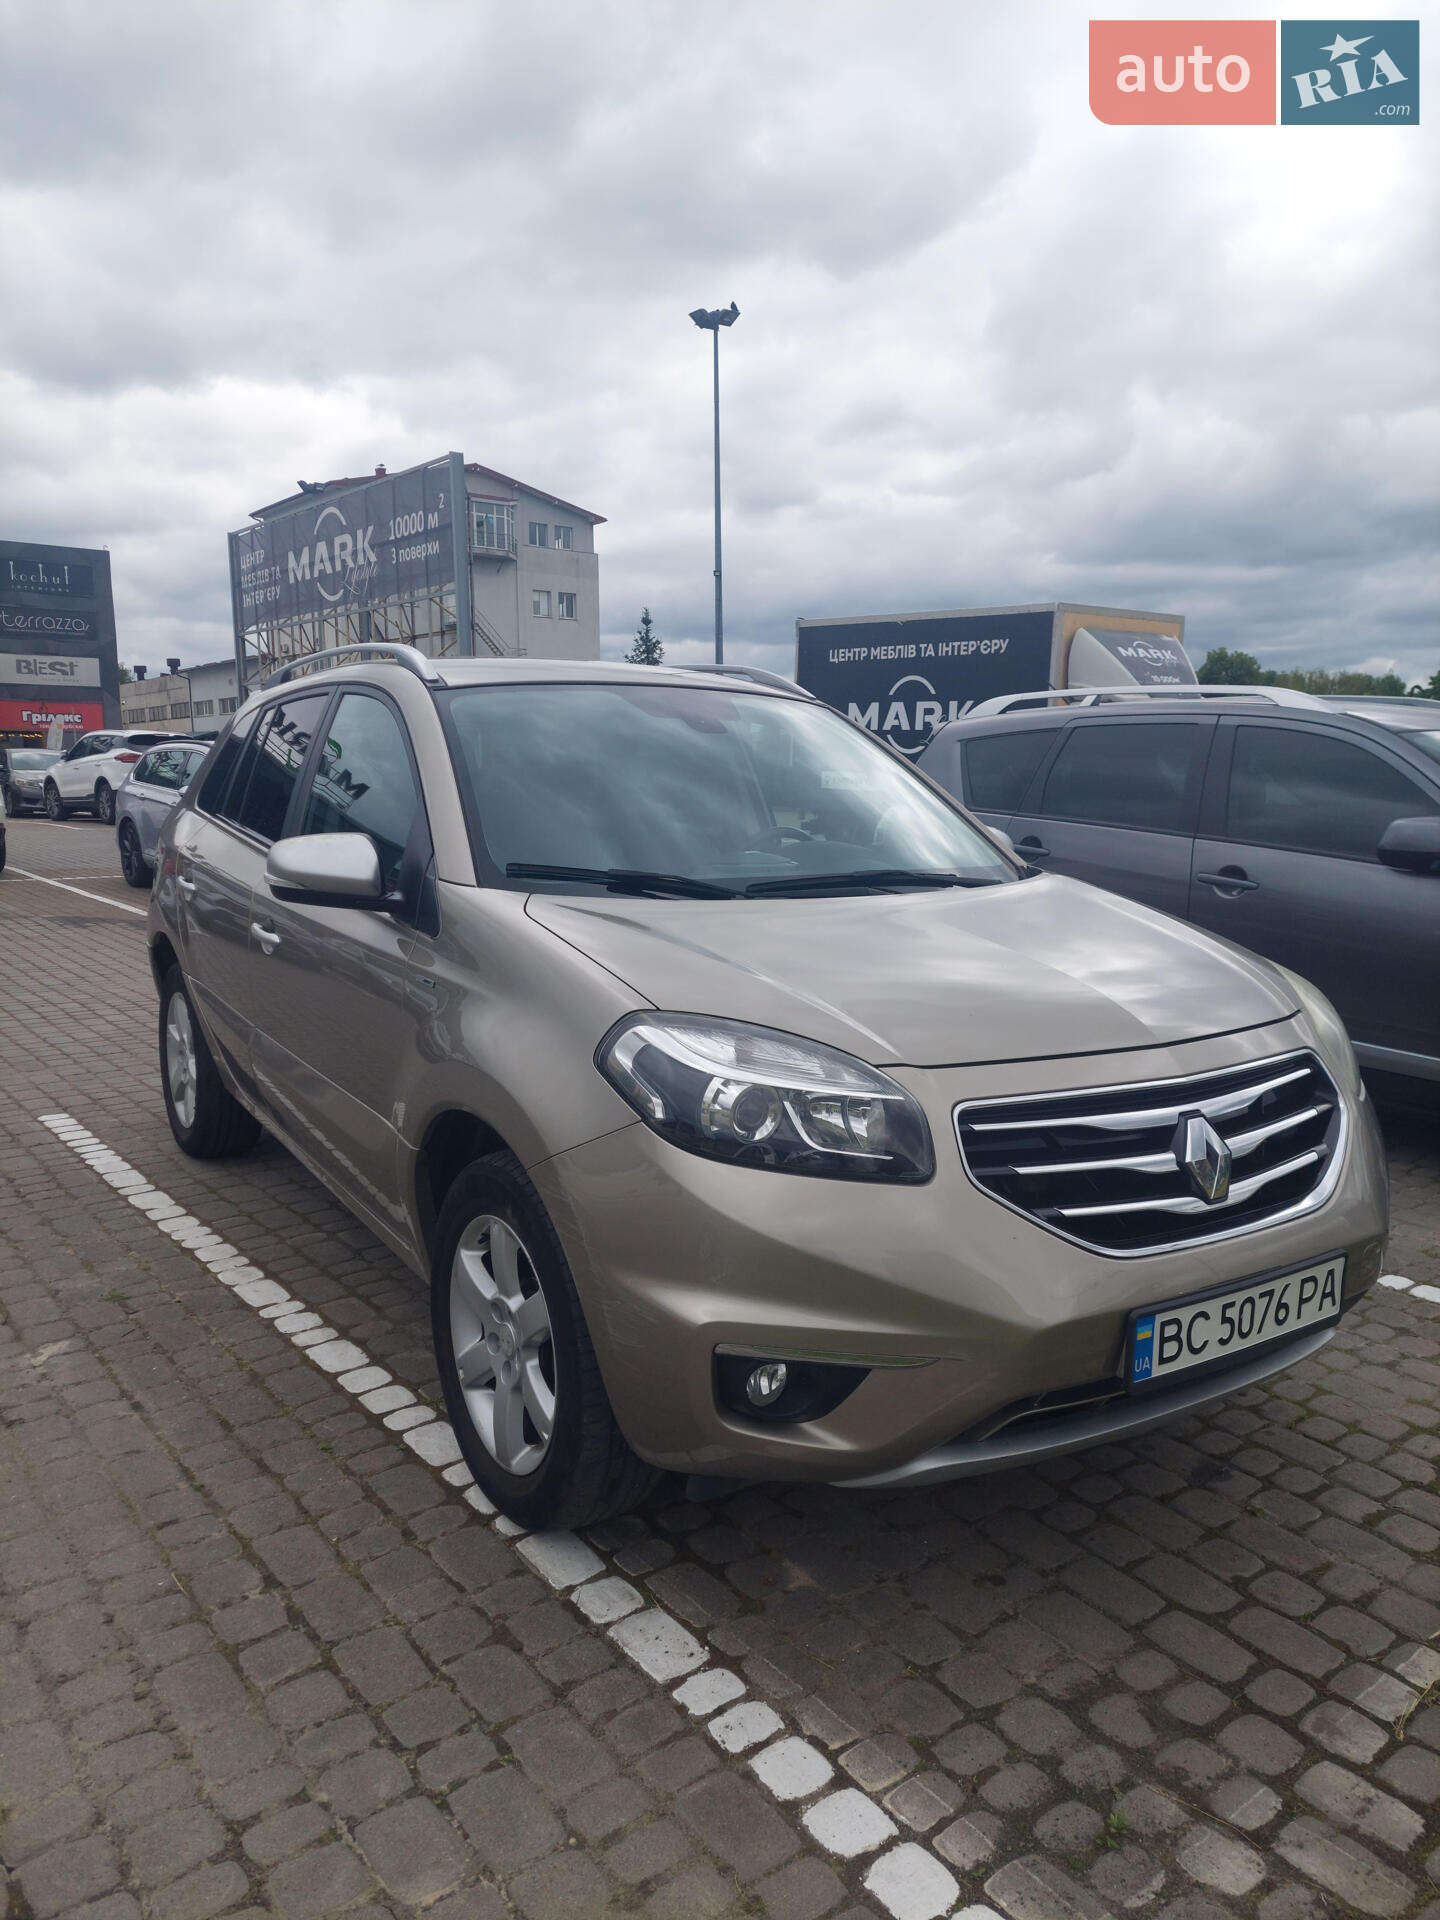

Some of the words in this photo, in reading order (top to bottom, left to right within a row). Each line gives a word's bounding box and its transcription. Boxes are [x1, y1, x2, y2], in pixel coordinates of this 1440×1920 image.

[389, 510, 425, 540] 10000
[240, 549, 265, 570] ЦЕНТР
[287, 525, 377, 584] MARK
[391, 547, 397, 565] 3
[399, 540, 440, 562] поверхи
[829, 647, 869, 663] ЦЕНТР
[870, 644, 916, 660] МЕБЛІВ
[919, 642, 936, 658] ТА
[1116, 646, 1178, 661] MARK
[1157, 1310, 1211, 1366] BC
[1217, 1282, 1292, 1346] 5076
[1296, 1267, 1337, 1321] PA
[1134, 1356, 1150, 1373] UA
